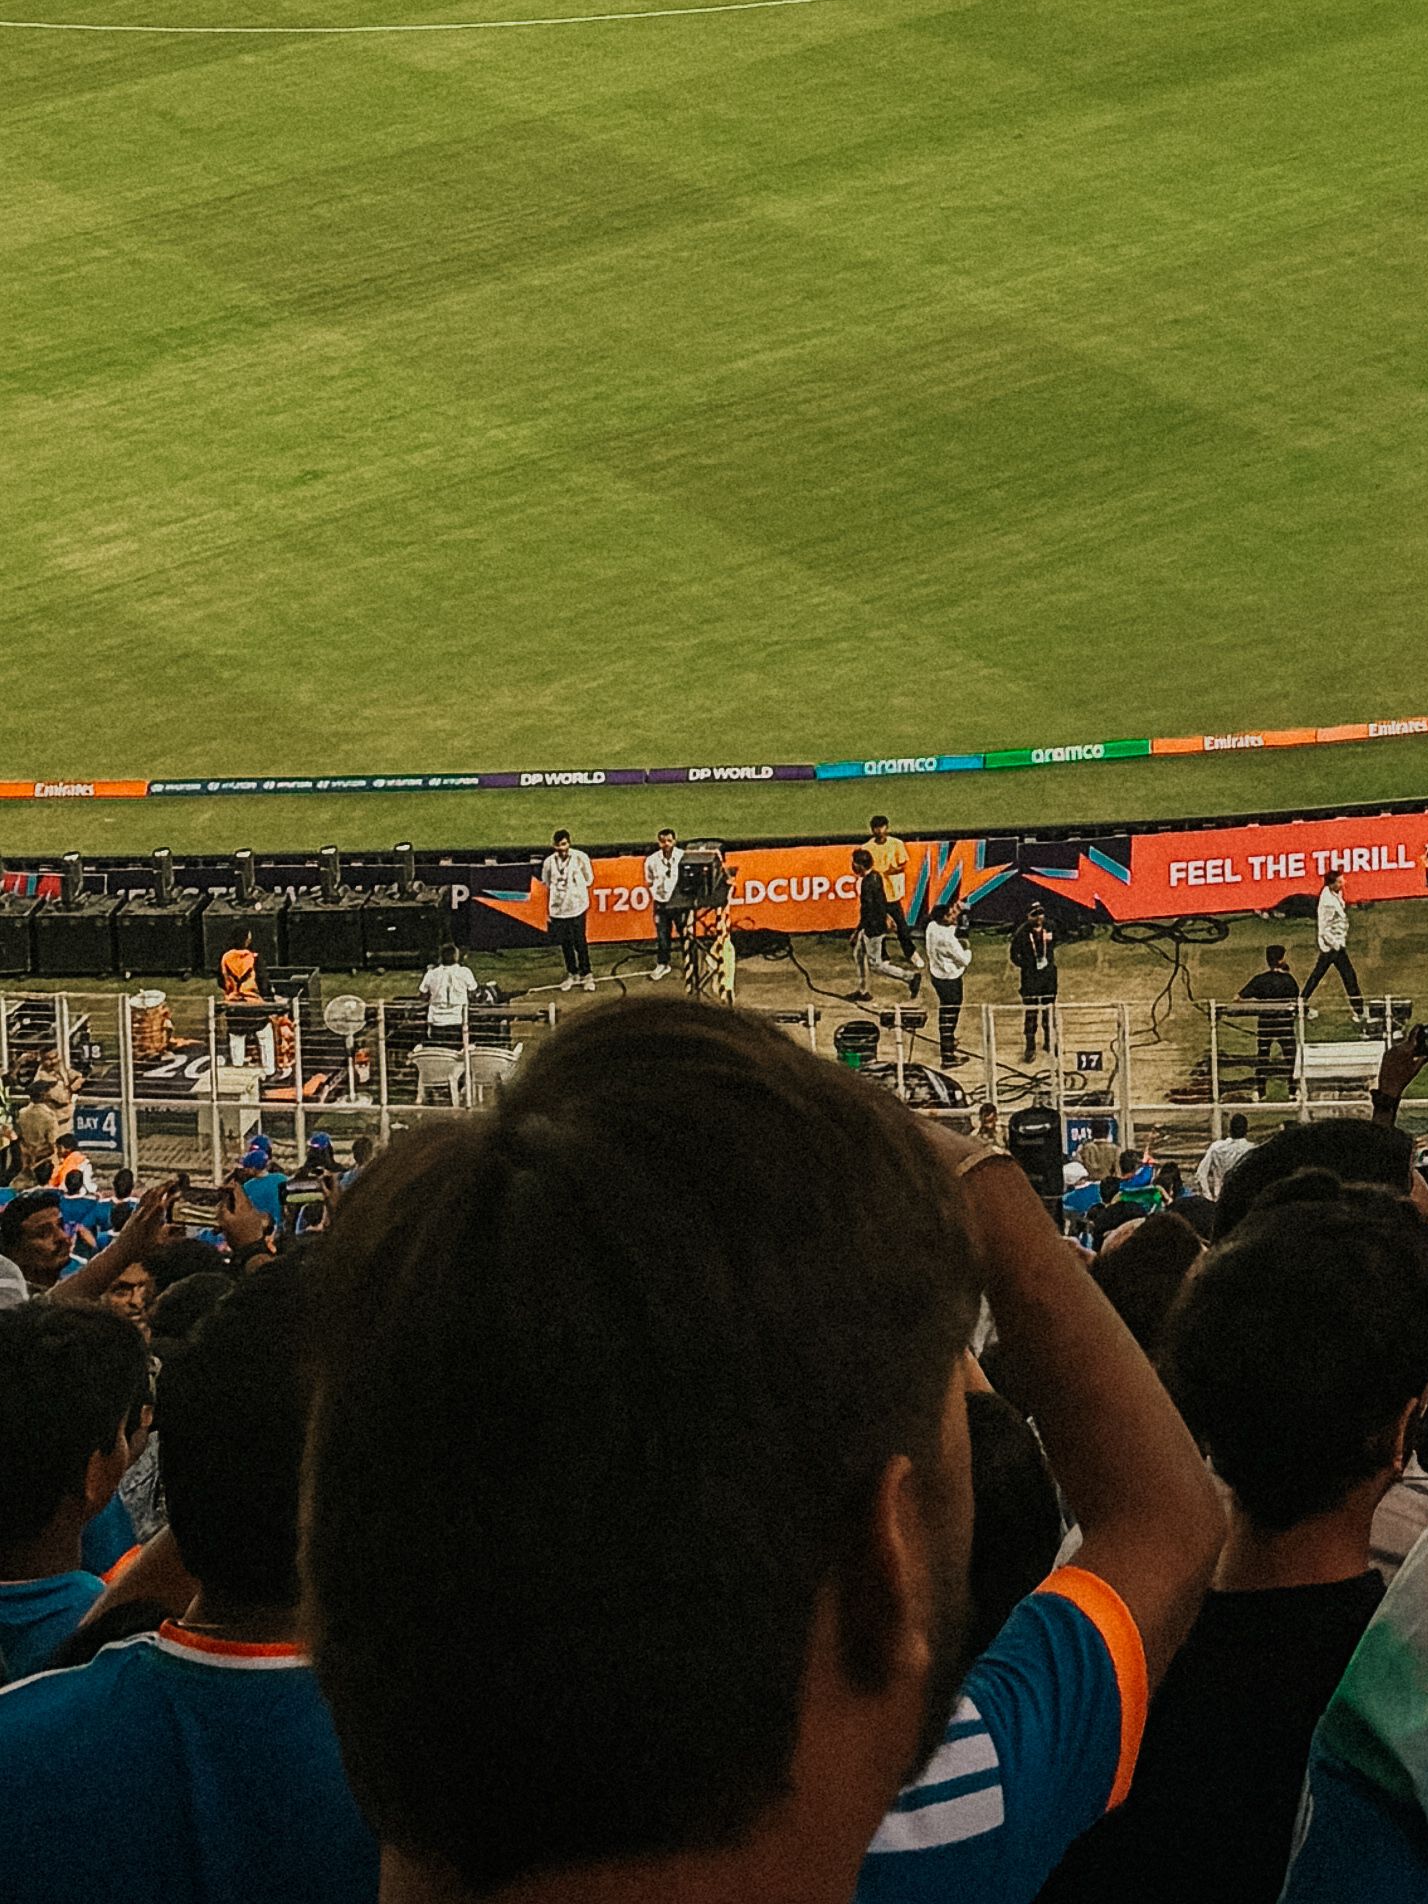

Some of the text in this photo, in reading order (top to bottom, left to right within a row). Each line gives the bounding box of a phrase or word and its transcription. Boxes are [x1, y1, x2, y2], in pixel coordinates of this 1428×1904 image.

[1031, 743, 1105, 764] aramco
[688, 766, 773, 781] DP WORLD
[864, 756, 937, 776] aramco
[520, 770, 605, 788] DP WORLD
[1169, 843, 1416, 887] FEEL THE THRILL
[76, 1111, 118, 1137] BAY 4
